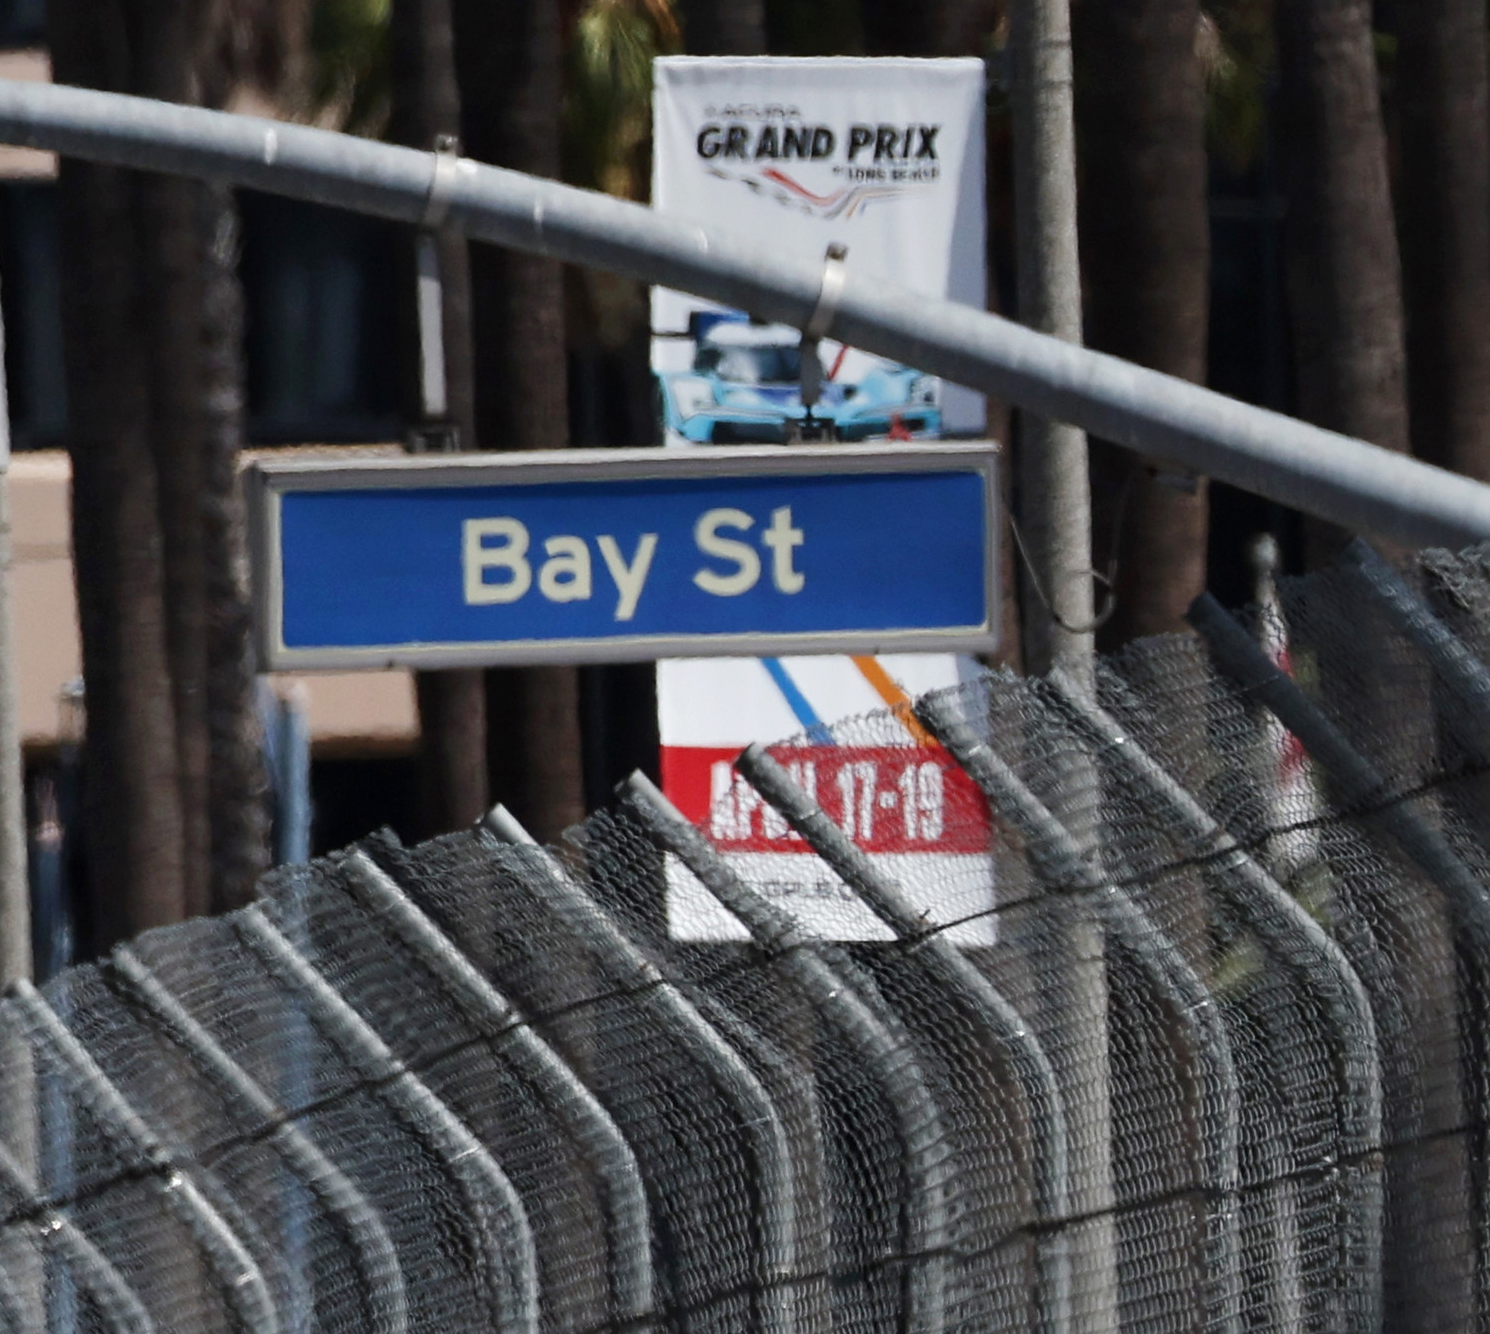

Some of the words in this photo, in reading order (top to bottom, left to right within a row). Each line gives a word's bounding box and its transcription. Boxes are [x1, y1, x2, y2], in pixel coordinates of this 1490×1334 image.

[697, 124, 835, 161] GRAND
[847, 123, 942, 162] PRIX
[461, 515, 658, 621] Bay
[691, 504, 805, 597] St
[837, 760, 946, 842] 17-19
